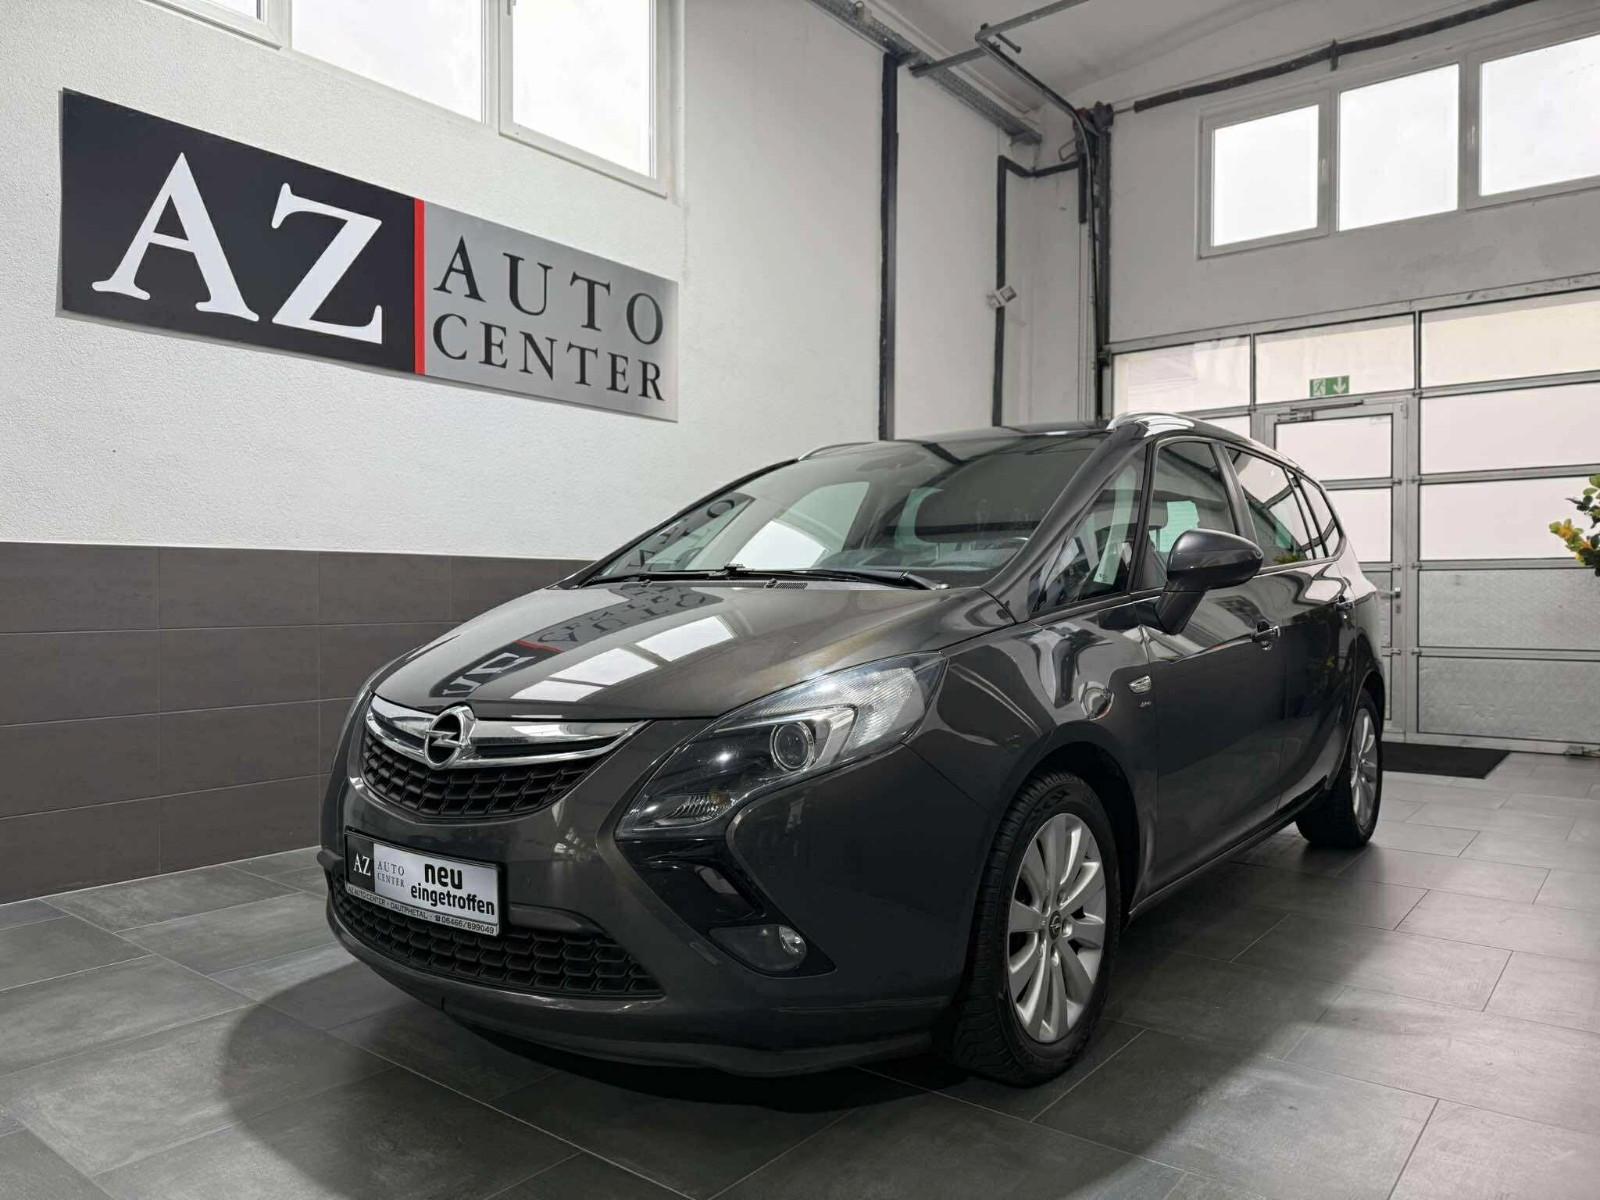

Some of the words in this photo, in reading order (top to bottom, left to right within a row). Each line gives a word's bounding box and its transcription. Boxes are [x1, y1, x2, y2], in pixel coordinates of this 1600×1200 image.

[91, 151, 384, 345] AZ
[432, 235, 665, 348] AUTO
[432, 313, 665, 402] CENTER
[353, 852, 371, 876] AZ
[377, 861, 405, 877] AUTO
[424, 863, 463, 890] neu
[377, 872, 405, 888] CENTER
[410, 882, 495, 916] eingetroffen
